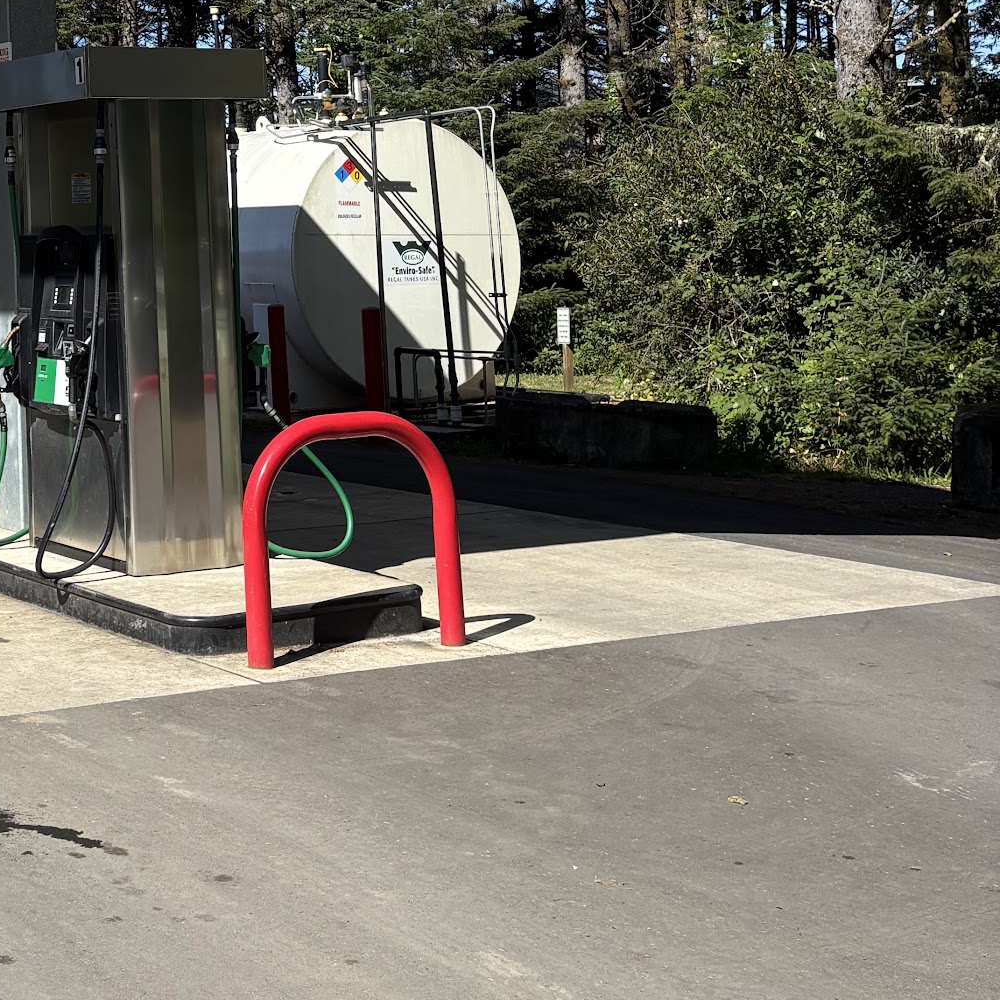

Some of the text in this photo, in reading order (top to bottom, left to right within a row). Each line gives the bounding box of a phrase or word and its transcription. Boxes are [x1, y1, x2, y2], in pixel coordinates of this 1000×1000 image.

[76, 57, 83, 83] 1
[347, 161, 352, 171] 3
[340, 169, 344, 179] 1
[354, 171, 360, 180] 0
